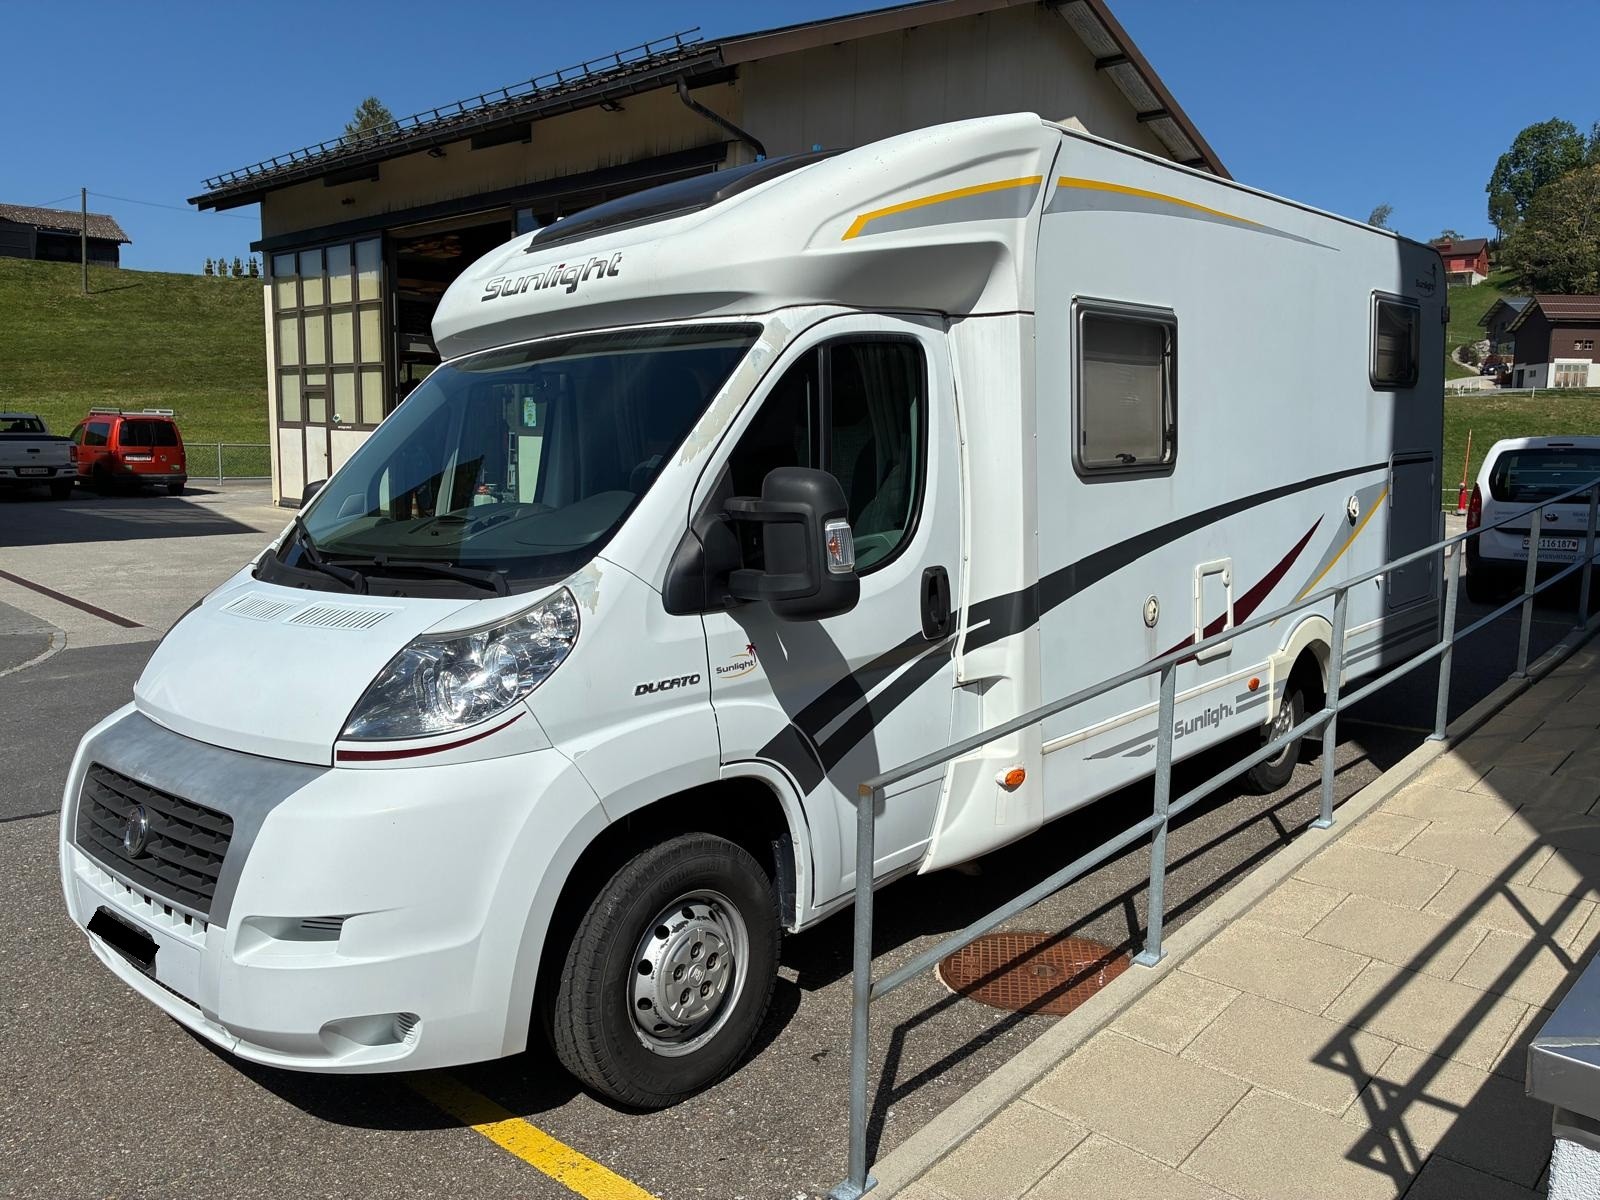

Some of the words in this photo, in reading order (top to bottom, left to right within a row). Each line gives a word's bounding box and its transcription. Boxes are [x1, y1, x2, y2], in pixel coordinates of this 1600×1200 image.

[481, 252, 622, 302] Sunlight
[1542, 539, 1571, 548] 116187
[716, 659, 754, 674] Sunlight
[634, 673, 701, 697] DUCATO
